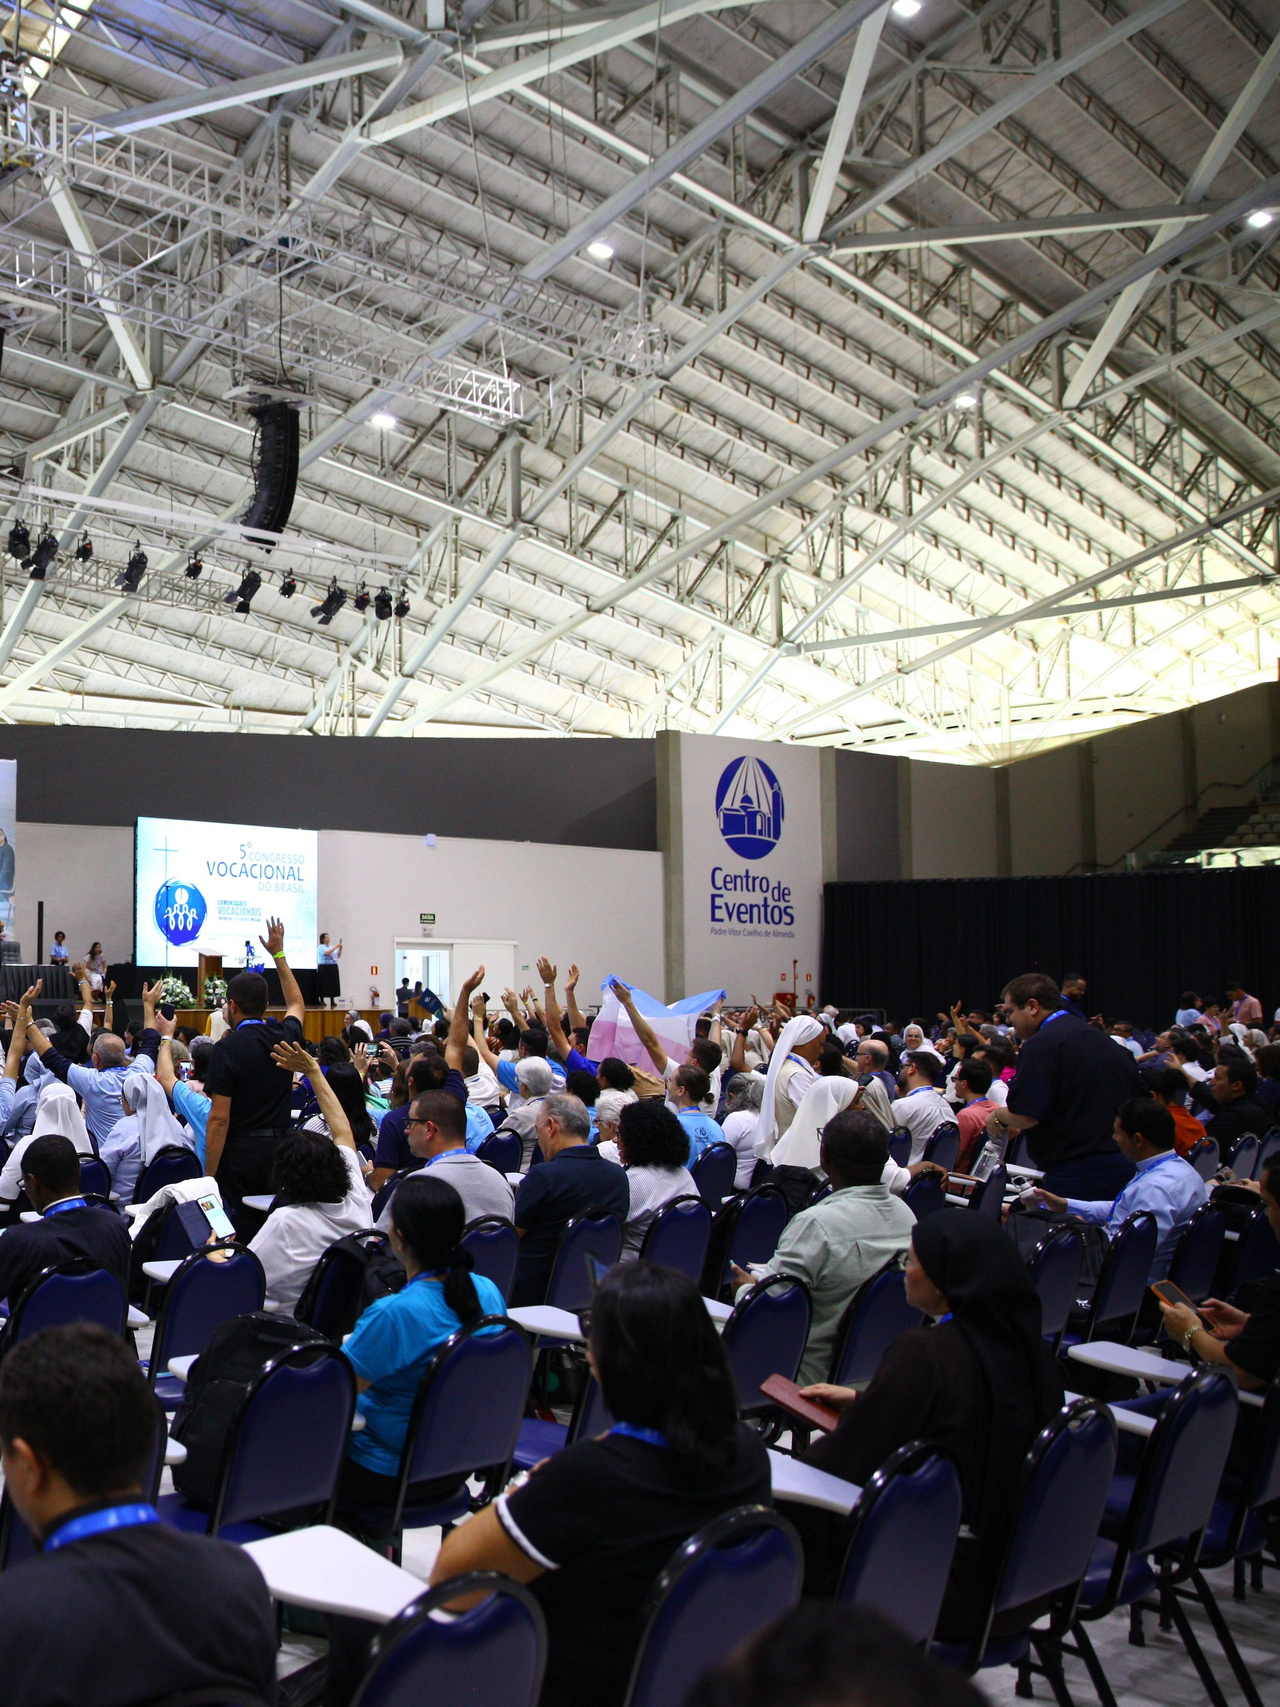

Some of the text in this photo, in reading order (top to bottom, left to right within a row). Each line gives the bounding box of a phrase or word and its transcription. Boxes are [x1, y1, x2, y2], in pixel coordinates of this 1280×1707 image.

[248, 851, 305, 865] CONGRESSO
[206, 861, 305, 882] VOCACIONAL
[274, 882, 306, 894] BRASIL
[710, 866, 791, 903] Centro de
[710, 893, 795, 926] Eventos
[710, 926, 726, 936] Padre
[742, 928, 764, 937] Coelho
[764, 930, 771, 938] de
[772, 930, 795, 938] Almeida
